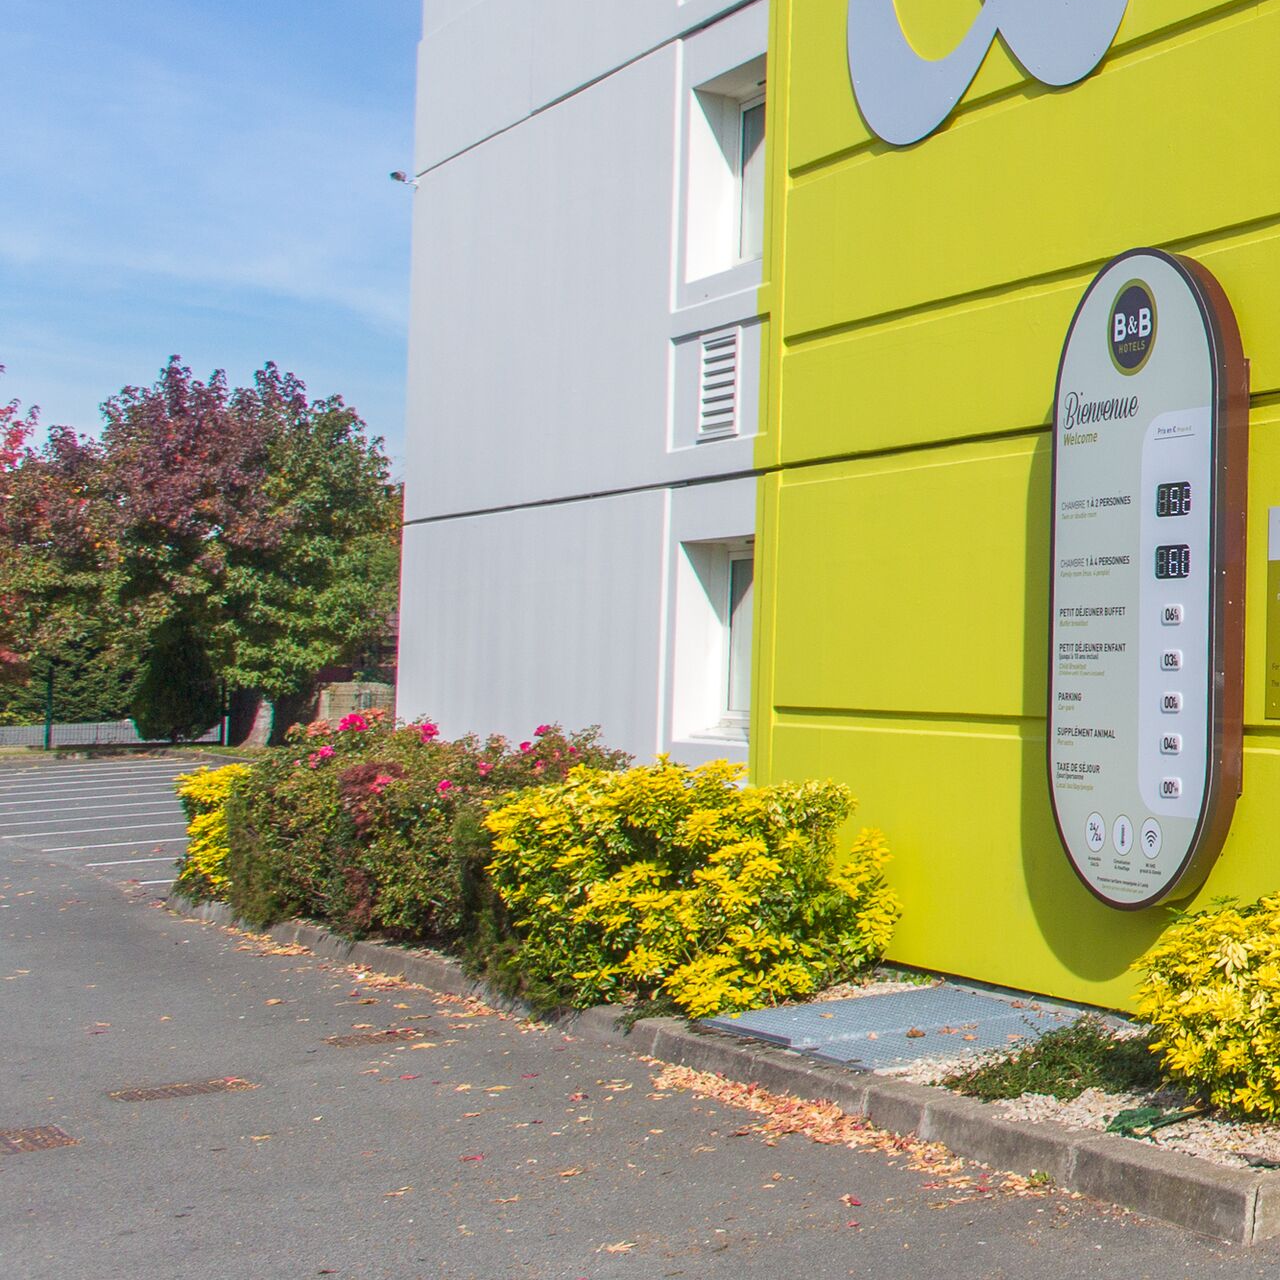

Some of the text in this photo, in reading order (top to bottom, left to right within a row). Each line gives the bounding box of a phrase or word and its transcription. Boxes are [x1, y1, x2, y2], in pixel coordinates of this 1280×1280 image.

[1114, 307, 1153, 342] B&B
[1118, 340, 1146, 354] HOTELS
[1063, 391, 1140, 430] Bienvenue
[1063, 430, 1098, 446] Welcome
[1100, 496, 1131, 507] PERSONNES
[1098, 555, 1130, 565] PERSONNES
[1060, 605, 1125, 617] PETIT DÉJEUNER BUFFET
[1059, 641, 1126, 652] PETIT DÉJEUNER ENFANT
[1058, 692, 1082, 702] PARKING
[1057, 725, 1115, 739] SUPPLÉMENT ANIMAL
[1056, 762, 1100, 773] TAXE DE SÉJOUR
